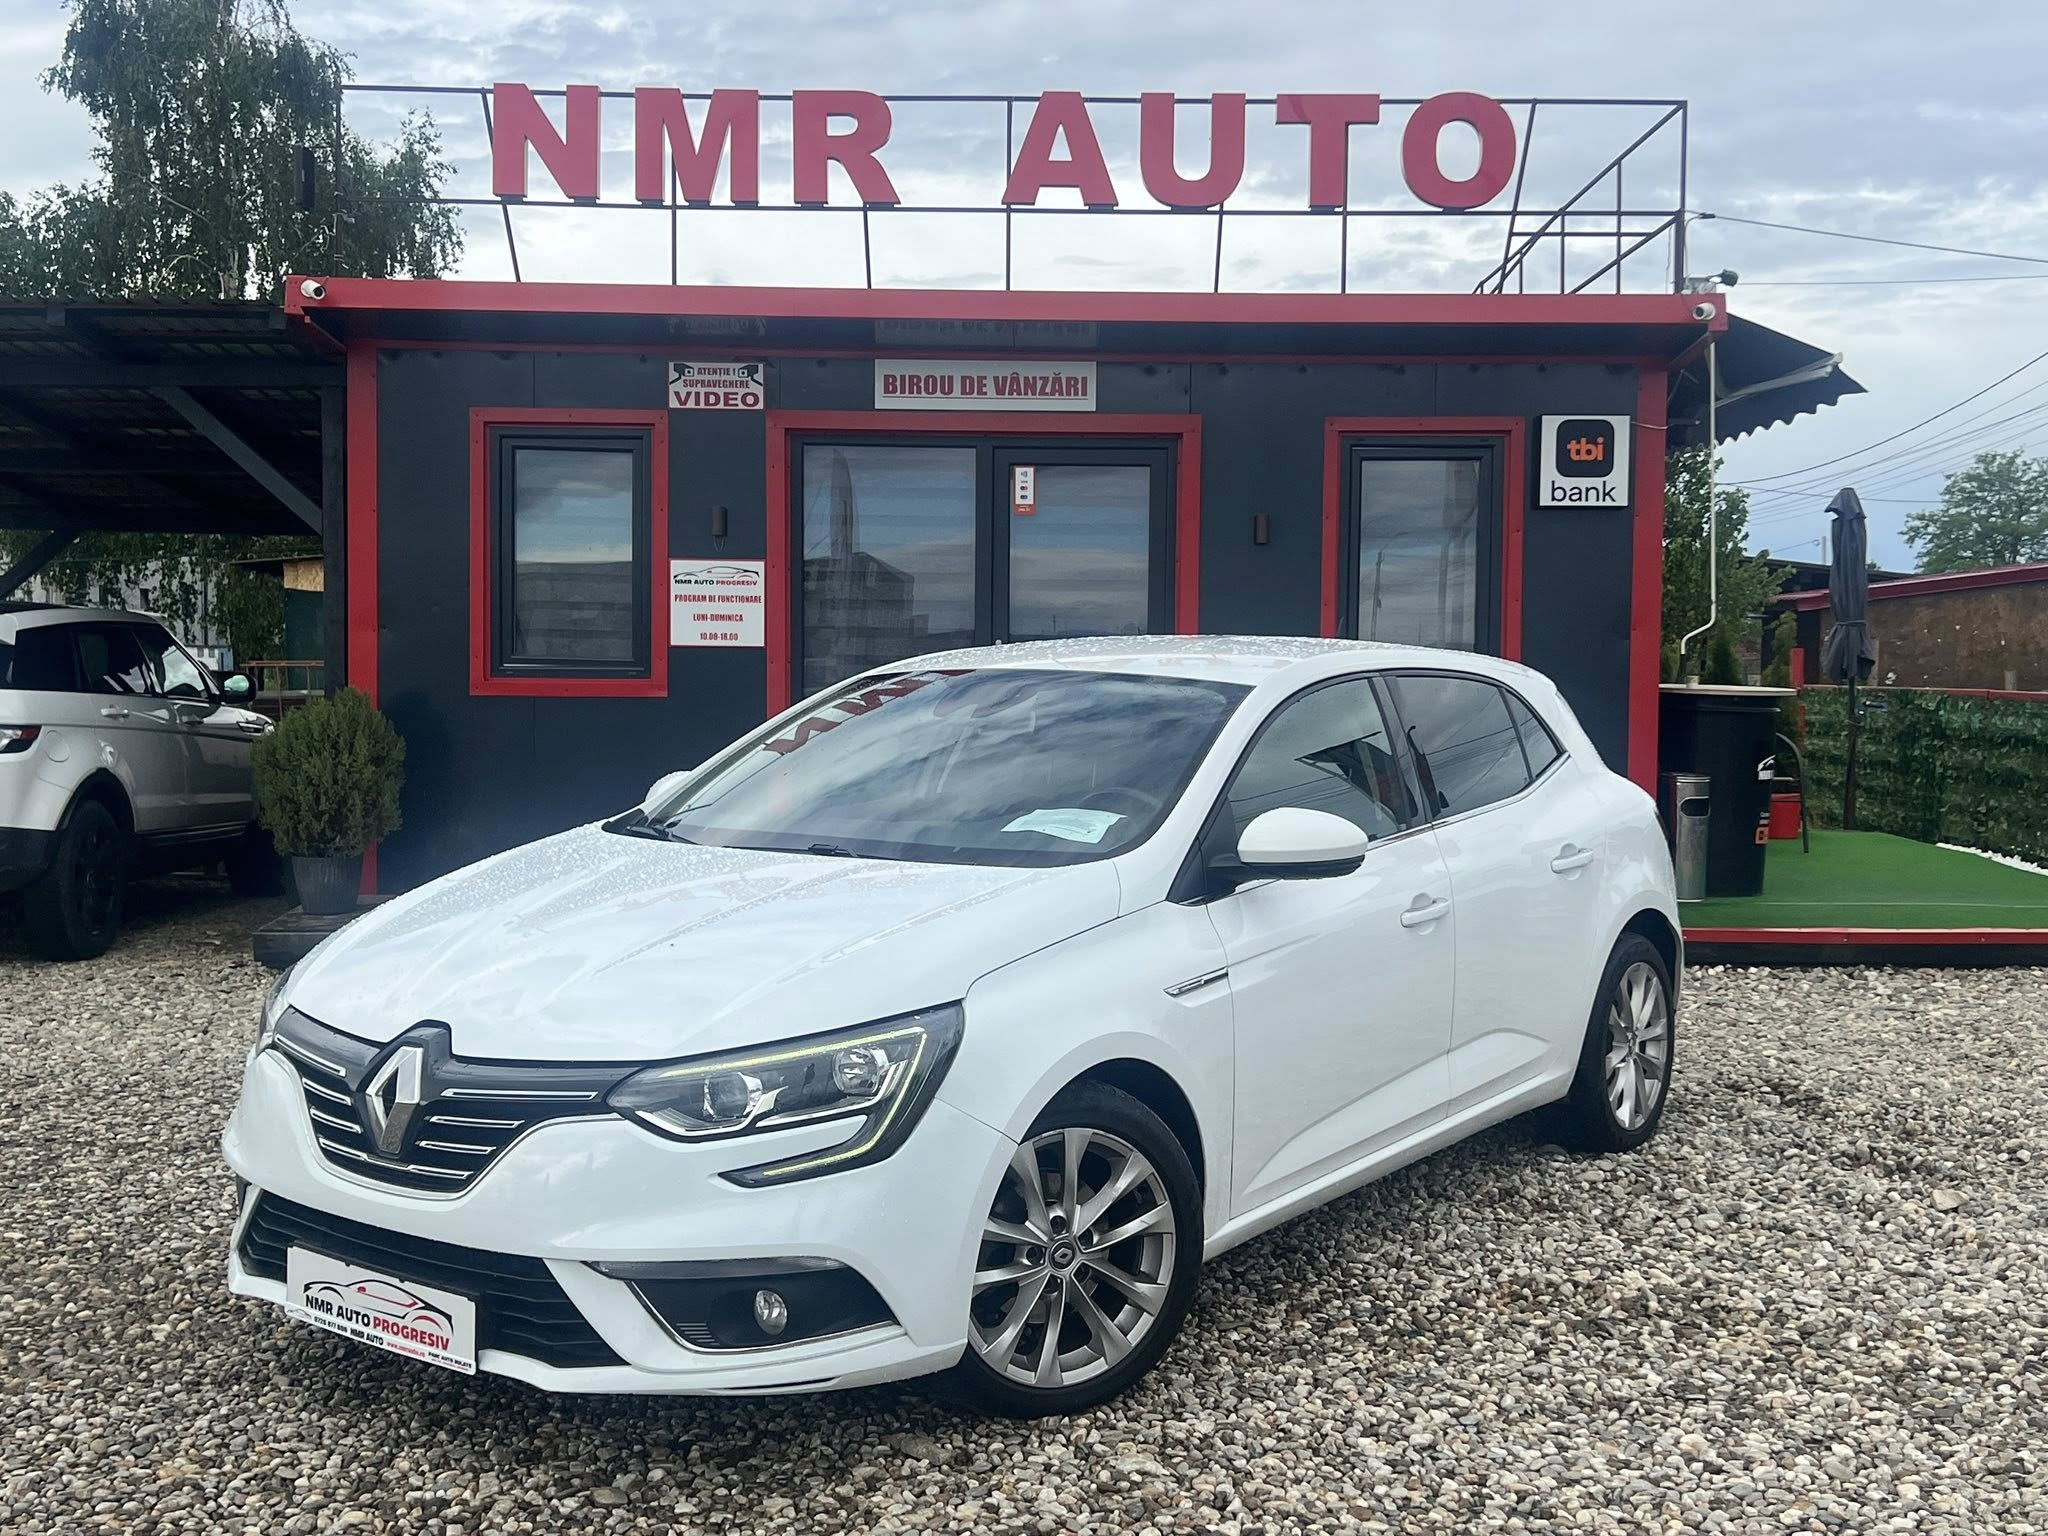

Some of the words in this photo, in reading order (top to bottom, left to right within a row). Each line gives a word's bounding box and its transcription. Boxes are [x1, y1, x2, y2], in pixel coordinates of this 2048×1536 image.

[492, 82, 901, 205] NMR
[1001, 91, 1517, 210] AUTO
[683, 379, 750, 389] SUPRAVEGHERE
[883, 374, 954, 395] BIROU
[960, 375, 988, 396] DE
[993, 372, 1088, 397] VÂNZĂRI
[673, 391, 760, 407] VIDEO
[1567, 436, 1604, 461] tbi
[1551, 480, 1616, 502] bank
[674, 594, 707, 602] PROGRAM
[708, 594, 716, 603] DE
[693, 613, 744, 622] LUNI-DUMINICA
[305, 1294, 333, 1315] NMR
[336, 1305, 371, 1327] AUTO
[373, 1316, 450, 1351] PROGRESIV
[366, 1333, 384, 1346] AUTO
